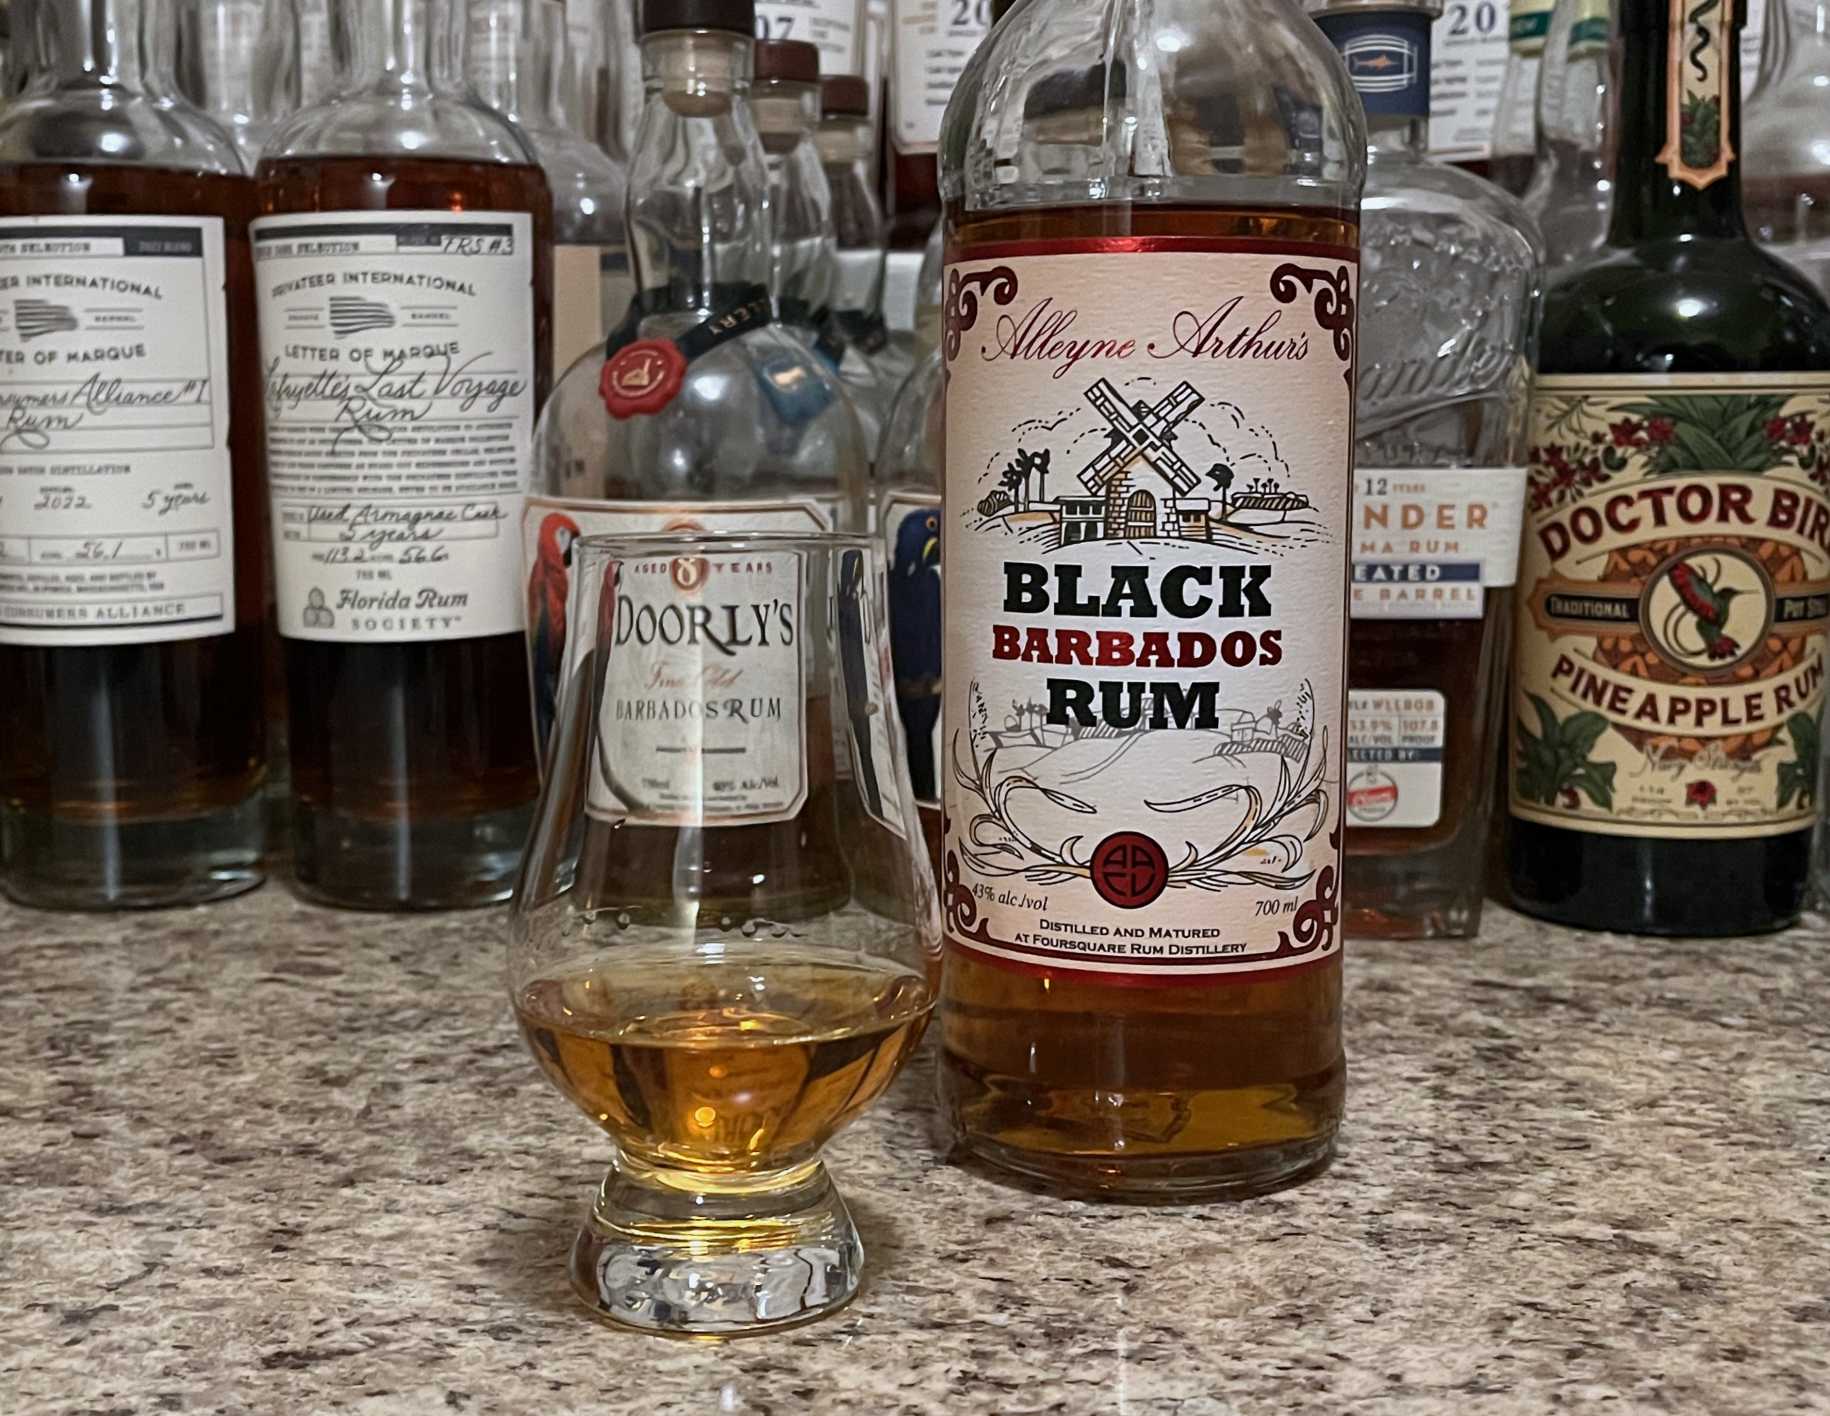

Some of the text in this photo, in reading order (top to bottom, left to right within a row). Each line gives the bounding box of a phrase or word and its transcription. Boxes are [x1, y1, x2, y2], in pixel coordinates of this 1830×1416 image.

[1449, 3, 1496, 34] 20
[26, 273, 163, 299] INTERNATIONAL
[342, 271, 476, 296] INTERNATIONAL
[981, 295, 1310, 380] Alleyne Arthur's
[34, 351, 57, 365] OF
[67, 343, 146, 363] MARQUE
[284, 341, 460, 362] LETTER OF MARQUE
[70, 371, 184, 416] Alliance
[433, 350, 528, 413] Voyage
[334, 395, 433, 438] Rum
[1364, 478, 1388, 496] 12
[1363, 503, 1489, 530] NDER
[1538, 484, 1830, 562] DOCTOR BIR
[1359, 540, 1460, 554] MA RUM
[634, 562, 667, 574] AGED
[712, 561, 773, 574] YEARS
[1354, 565, 1441, 581] EATED
[336, 588, 469, 610] Florida Rum
[1003, 561, 1272, 618] BLACK
[1379, 588, 1476, 601] BARREL
[96, 603, 186, 619] ALLIANCE
[614, 595, 794, 657] DOORLY'S
[992, 624, 1283, 668] BARBADOS
[1551, 653, 1824, 728] PINEAPPLE RUM
[615, 697, 782, 724] BARBADOS RUM
[1046, 678, 1221, 730] RUM
[972, 883, 996, 901] 43%
[1255, 895, 1299, 917] 700 ml
[1032, 934, 1127, 954] FOURSQUARE
[1130, 943, 1164, 955] RUM
[1168, 943, 1248, 955] DISTILLERY
[1113, 927, 1145, 938] AND
[1149, 927, 1221, 939] MATURED
